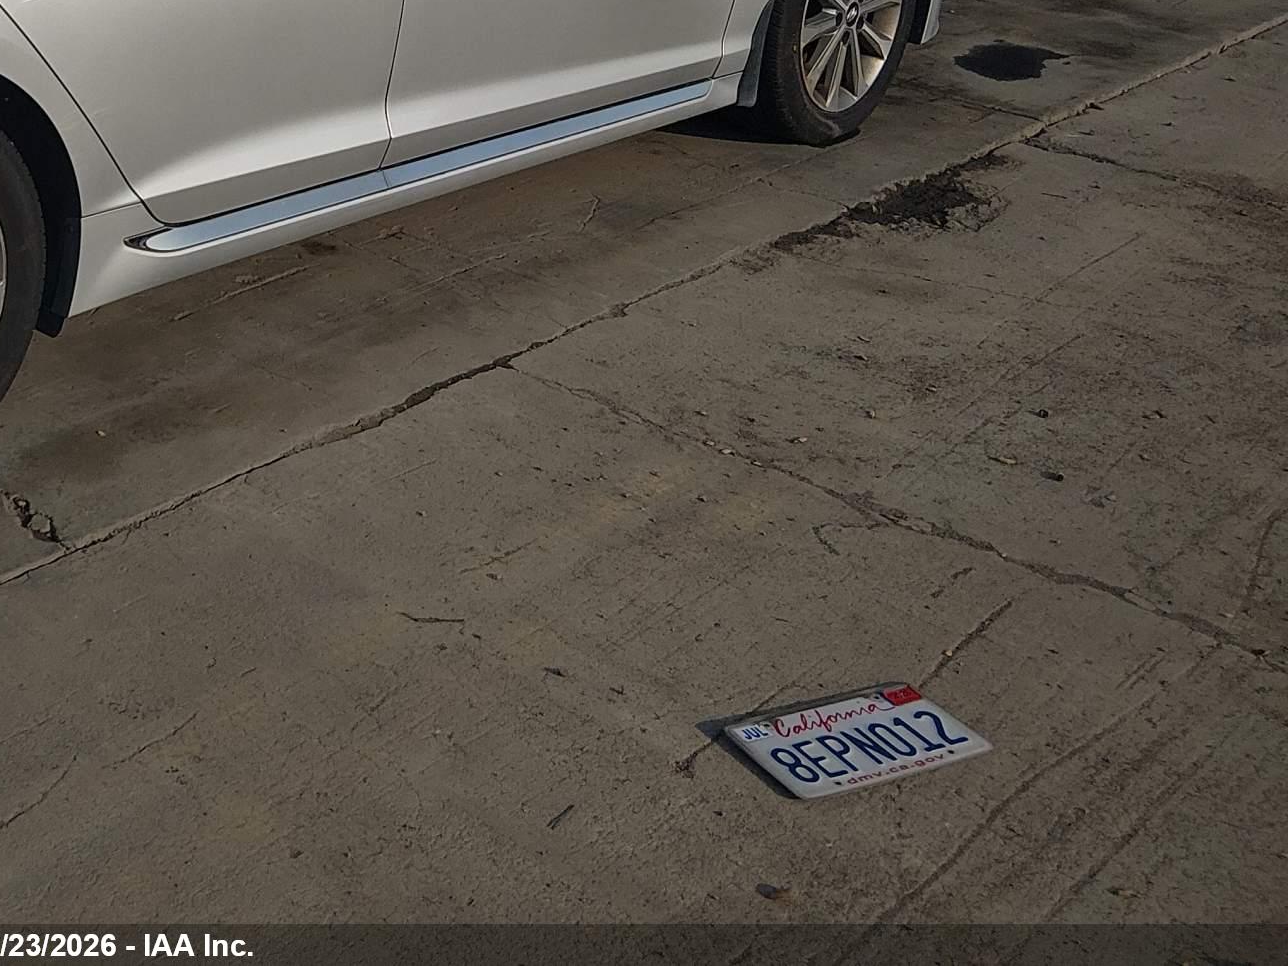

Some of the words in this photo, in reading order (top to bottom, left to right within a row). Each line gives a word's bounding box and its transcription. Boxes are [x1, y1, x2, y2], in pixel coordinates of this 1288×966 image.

[742, 723, 768, 740] JUL
[773, 701, 895, 738] California
[770, 710, 968, 783] 8EPN012
[847, 753, 944, 785] dmv.ca.gov
